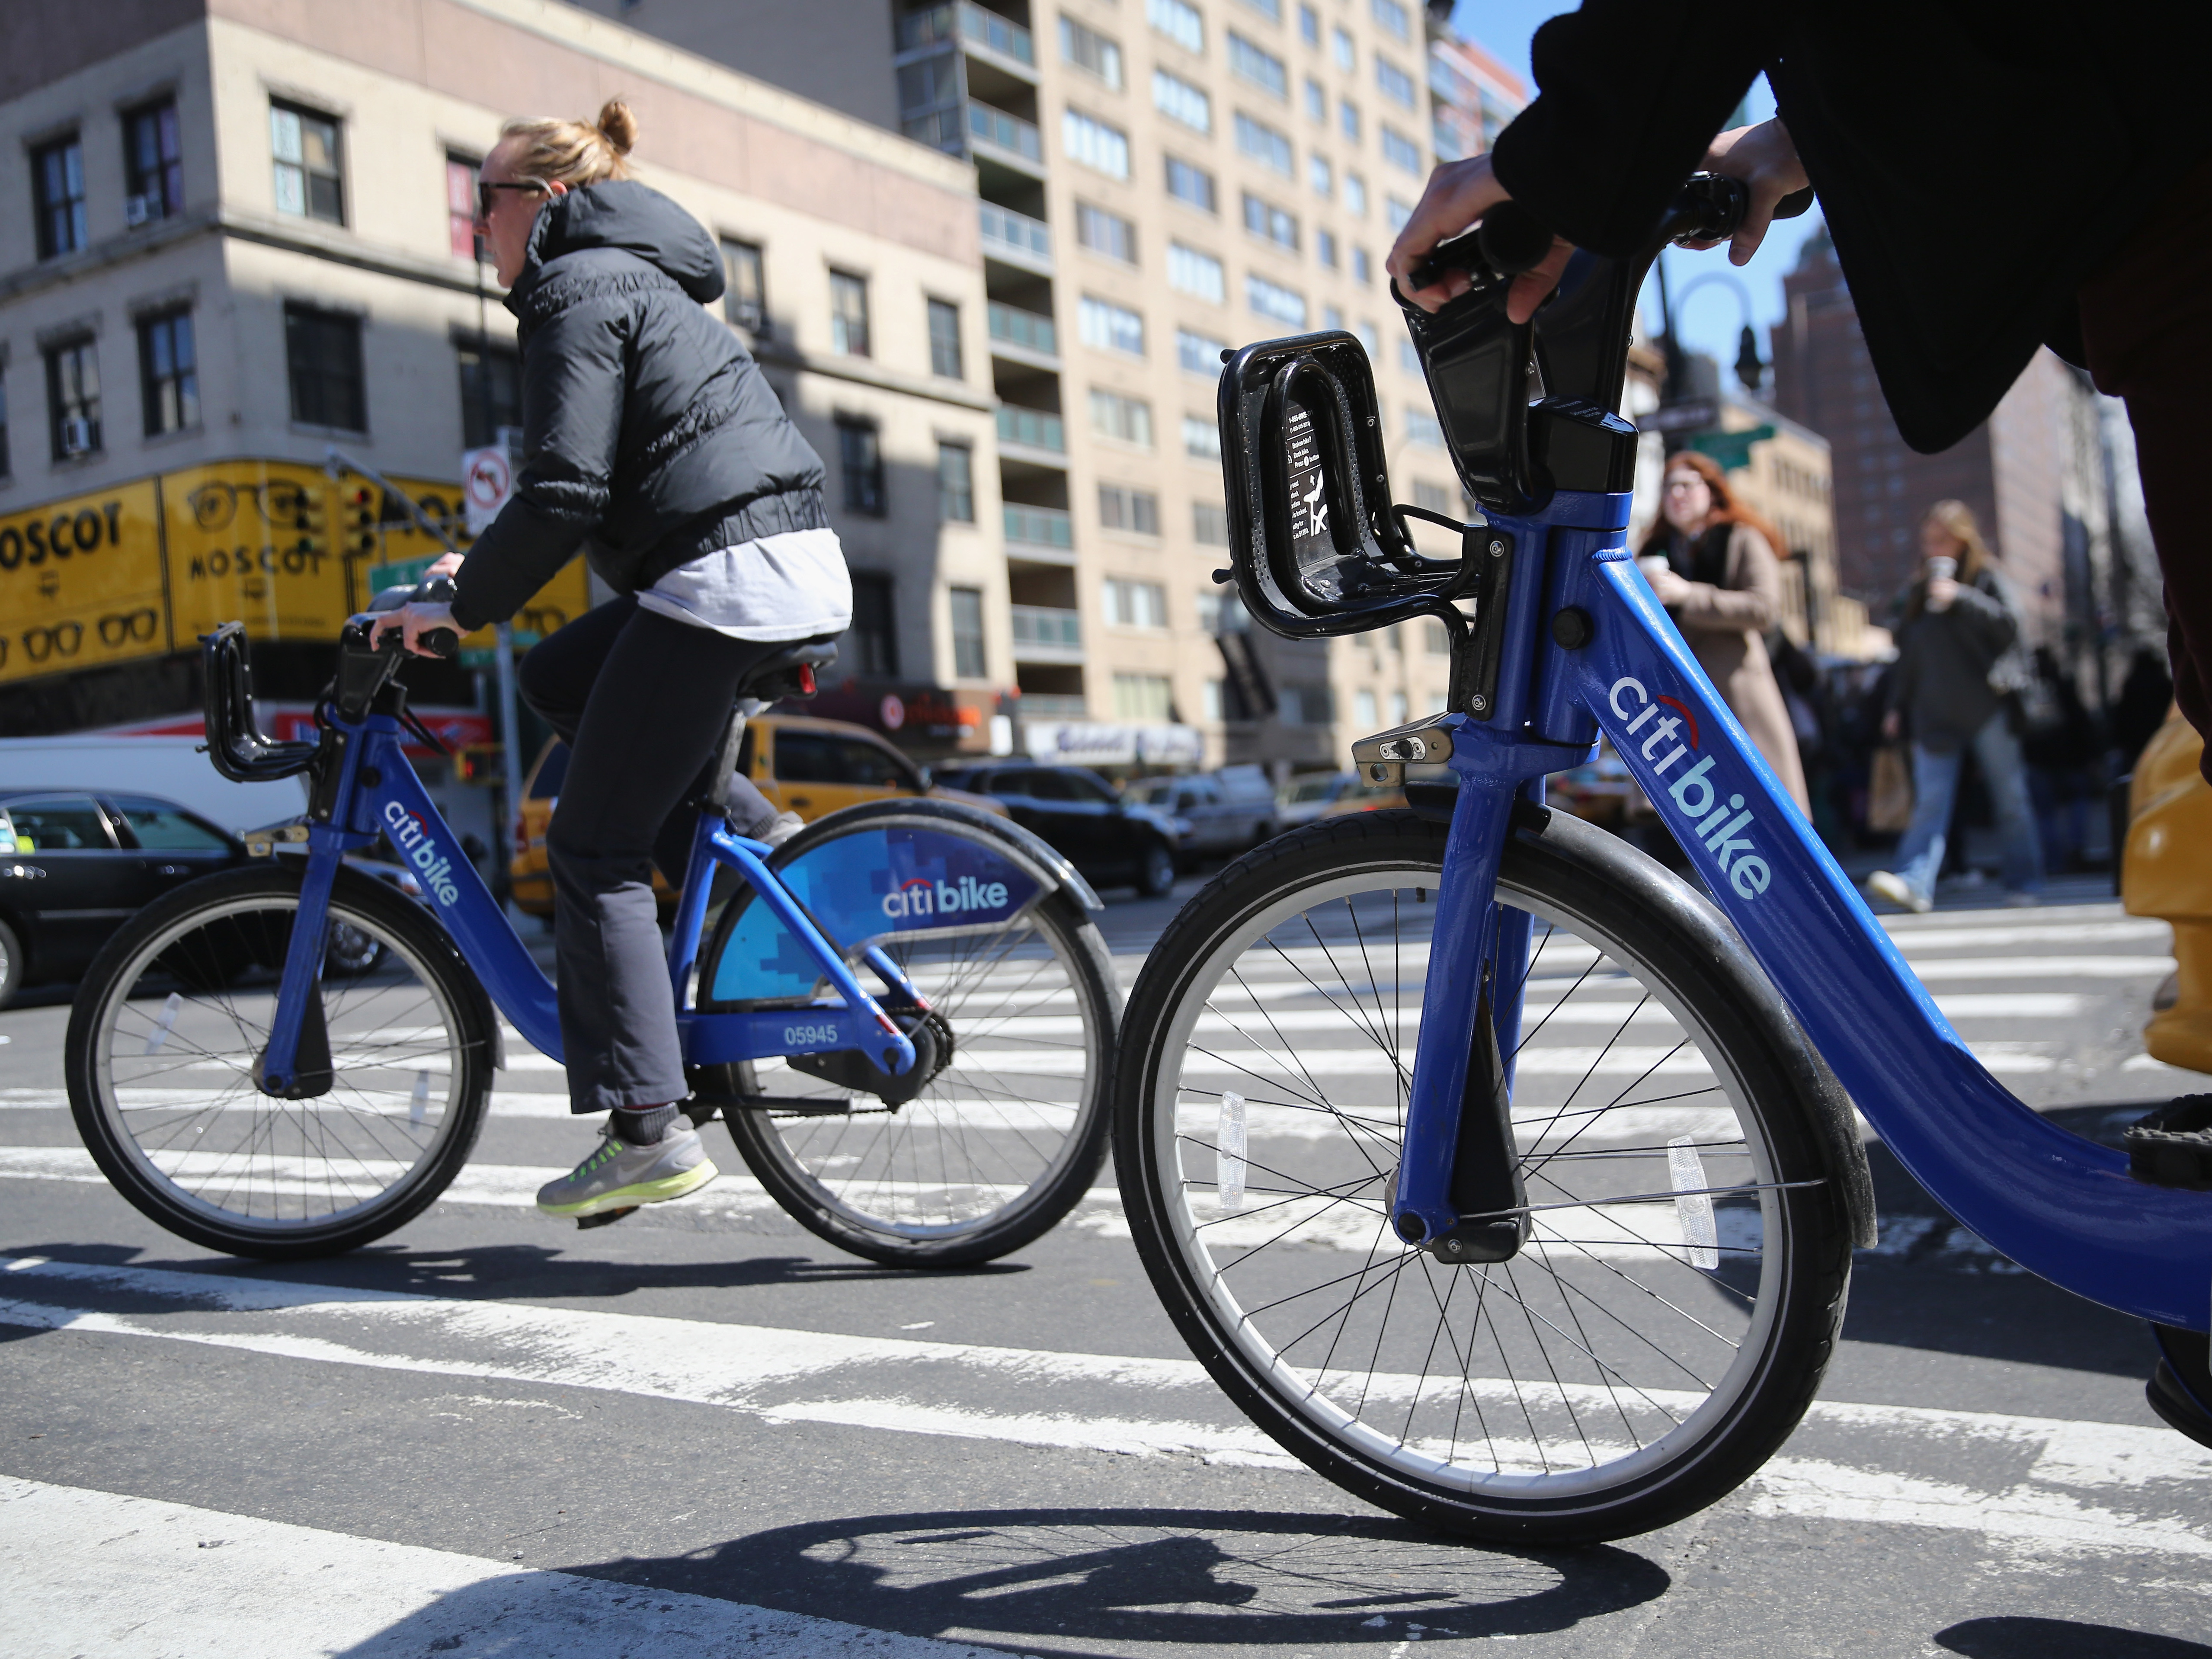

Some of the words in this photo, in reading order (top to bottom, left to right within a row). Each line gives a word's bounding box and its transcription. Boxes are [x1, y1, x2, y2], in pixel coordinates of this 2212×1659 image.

[1292, 440, 1303, 449] Broken
[1303, 436, 1311, 445] bike?
[1293, 450, 1302, 459] Dock
[1309, 454, 1319, 462] button
[0, 501, 122, 570] OSCOT
[191, 546, 327, 580] MOSCOT
[1610, 677, 1698, 775] citi
[1668, 755, 1770, 900] bike
[384, 801, 428, 849] citi
[412, 839, 458, 906] bike
[883, 878, 933, 917] citi
[937, 876, 1008, 913] bike
[784, 1025, 838, 1046] 05945
